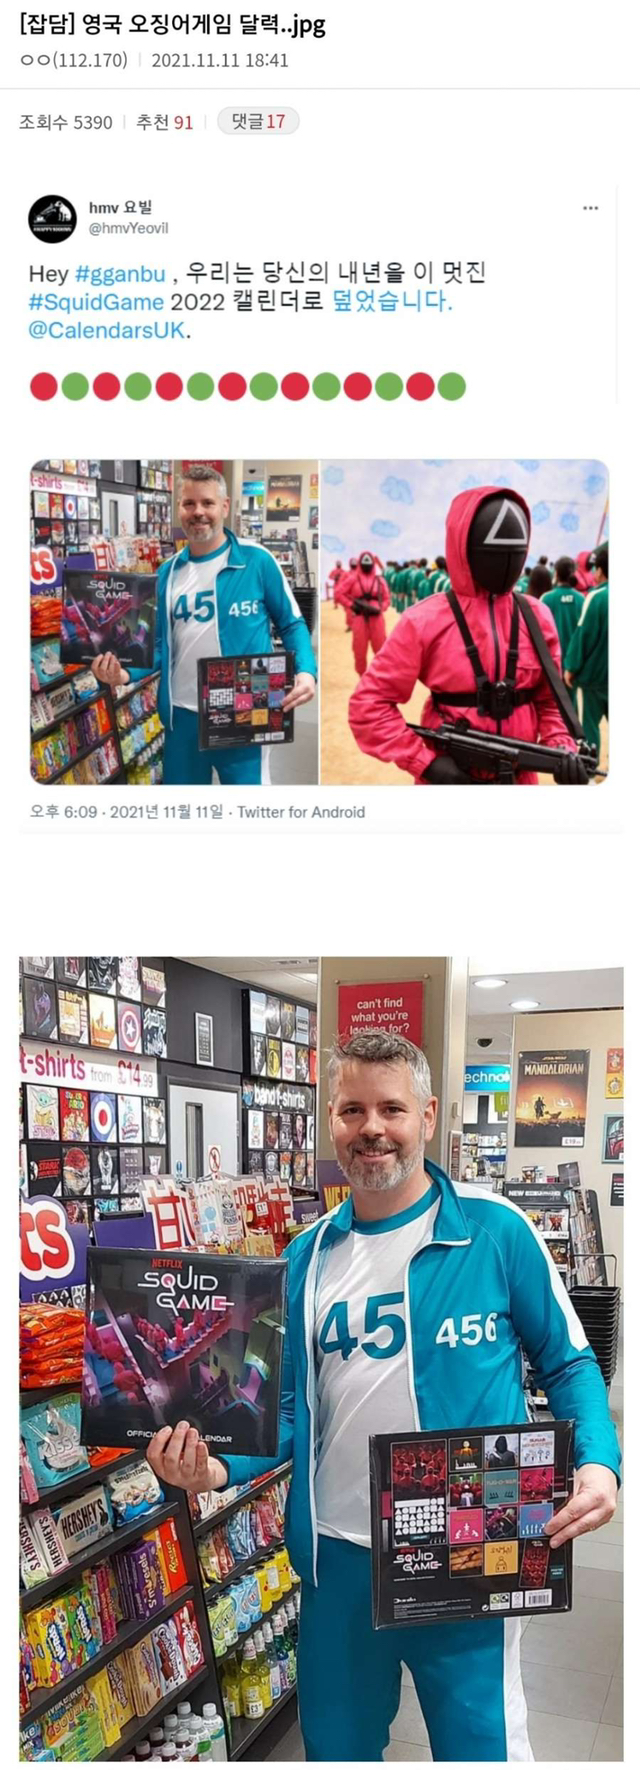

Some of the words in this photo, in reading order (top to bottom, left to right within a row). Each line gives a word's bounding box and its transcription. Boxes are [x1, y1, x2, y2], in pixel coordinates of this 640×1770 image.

[20, 12, 75, 35] [잡담]
[83, 13, 122, 35] 영국
[129, 13, 231, 35] 오징어게임
[240, 12, 327, 38] 달력..jpg
[152, 53, 240, 67] 2021.11.11
[246, 53, 289, 67] 18:41
[19, 115, 68, 131] 조회수
[74, 116, 113, 129] 5390
[137, 114, 169, 131] 추천
[174, 116, 193, 130] 91
[90, 202, 119, 214] hmv
[124, 200, 151, 215] 요빌
[89, 222, 169, 236] @hmvYeovil
[29, 265, 70, 286] Hey
[75, 264, 165, 286] #gganbu
[186, 261, 254, 284] 우리는
[263, 261, 328, 285] 당신의
[339, 261, 405, 284] 내년을
[414, 261, 432, 284] 이
[444, 261, 485, 283] 멋진
[28, 293, 164, 314] #SquidGame
[171, 293, 225, 311] 2022
[233, 290, 323, 312] 캘린더로
[333, 290, 453, 312] 덮었습니다.
[28, 321, 191, 340] @CalendarsUK.
[86, 577, 126, 592] SQUID
[95, 590, 133, 601] GAME
[173, 590, 215, 623] 45
[31, 804, 60, 819] 오후
[65, 805, 97, 819] 6:09
[110, 804, 158, 819] 2021년
[164, 805, 191, 819] 11월
[197, 804, 223, 819] 11일
[237, 805, 285, 819] Twitter
[288, 805, 308, 819] for
[311, 805, 366, 819] Android
[357, 998, 381, 1009] can't
[384, 997, 403, 1008] find
[351, 1012, 376, 1023] what
[378, 1010, 409, 1023] you're
[388, 1023, 410, 1034] for?
[20, 1046, 86, 1081] t-shirts
[91, 1066, 113, 1083] from
[524, 1063, 584, 1076] MANDALORIAN
[254, 1083, 275, 1104] band
[151, 1258, 183, 1269] NETFLIX
[137, 1265, 219, 1291] SQUID
[156, 1292, 235, 1316] GAME
[319, 1291, 407, 1361] 45
[435, 1312, 498, 1348] 456
[200, 1434, 232, 1443] LENDAR
[61, 1499, 105, 1540] HERSHEY'S
[38, 1516, 63, 1568] HERSHEY'S
[393, 1549, 434, 1563] SQUID
[402, 1561, 443, 1575] GAME
